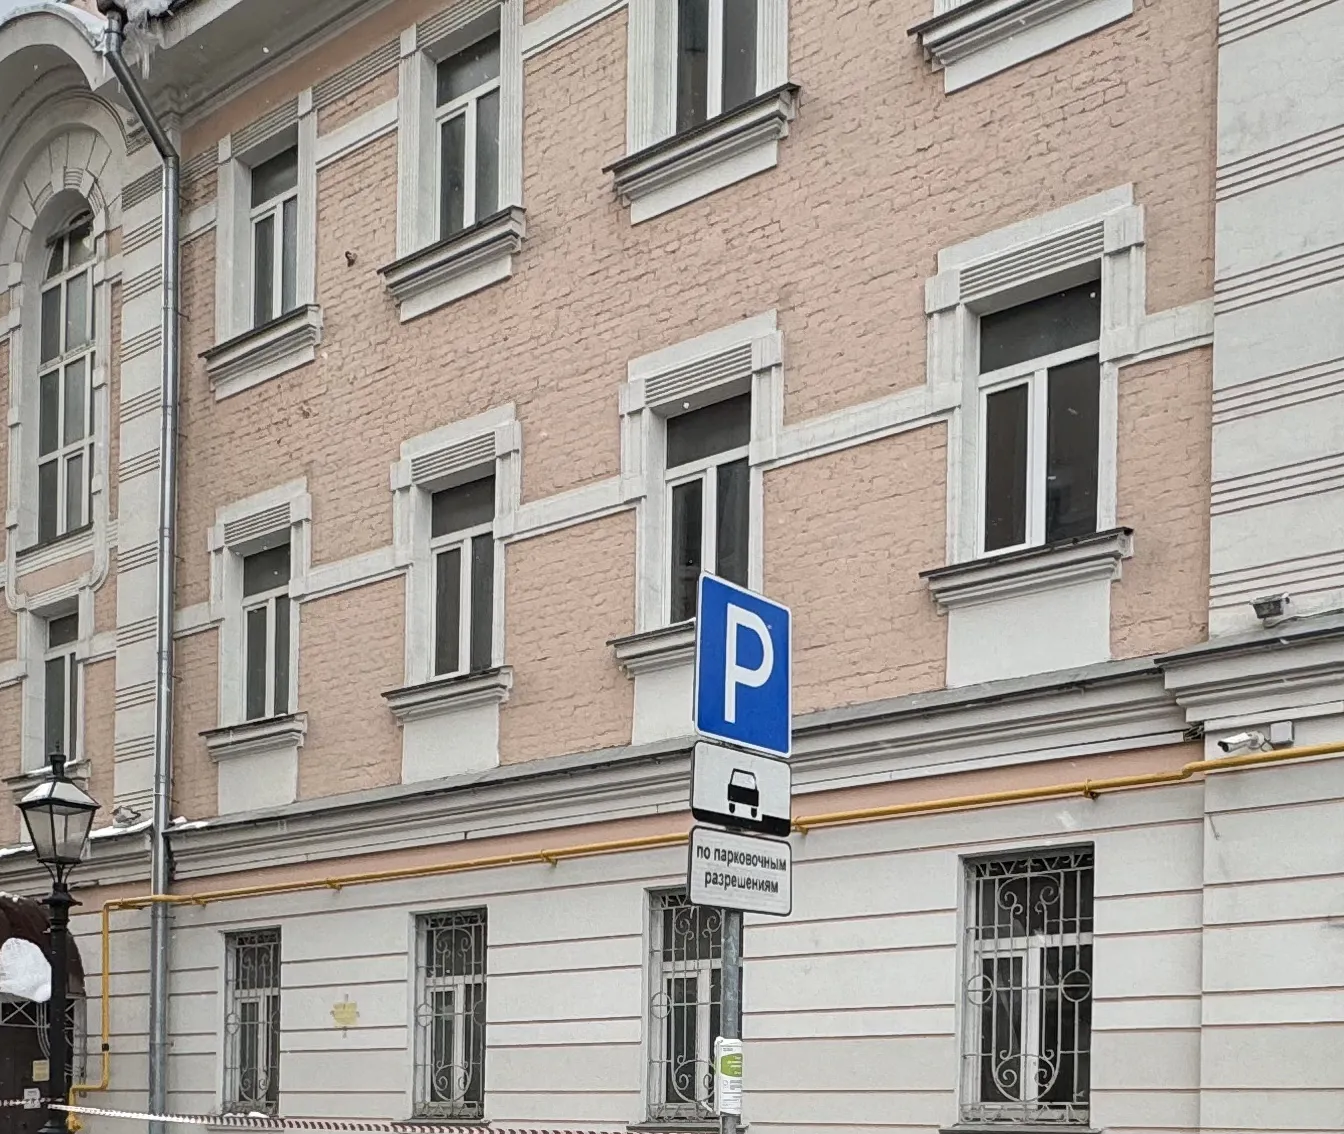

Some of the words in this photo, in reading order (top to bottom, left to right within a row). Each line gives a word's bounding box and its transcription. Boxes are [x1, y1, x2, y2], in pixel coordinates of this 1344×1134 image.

[724, 602, 774, 724] P
[696, 845, 711, 860] по
[714, 848, 787, 871] парковочным
[705, 871, 779, 893] разрешениям
